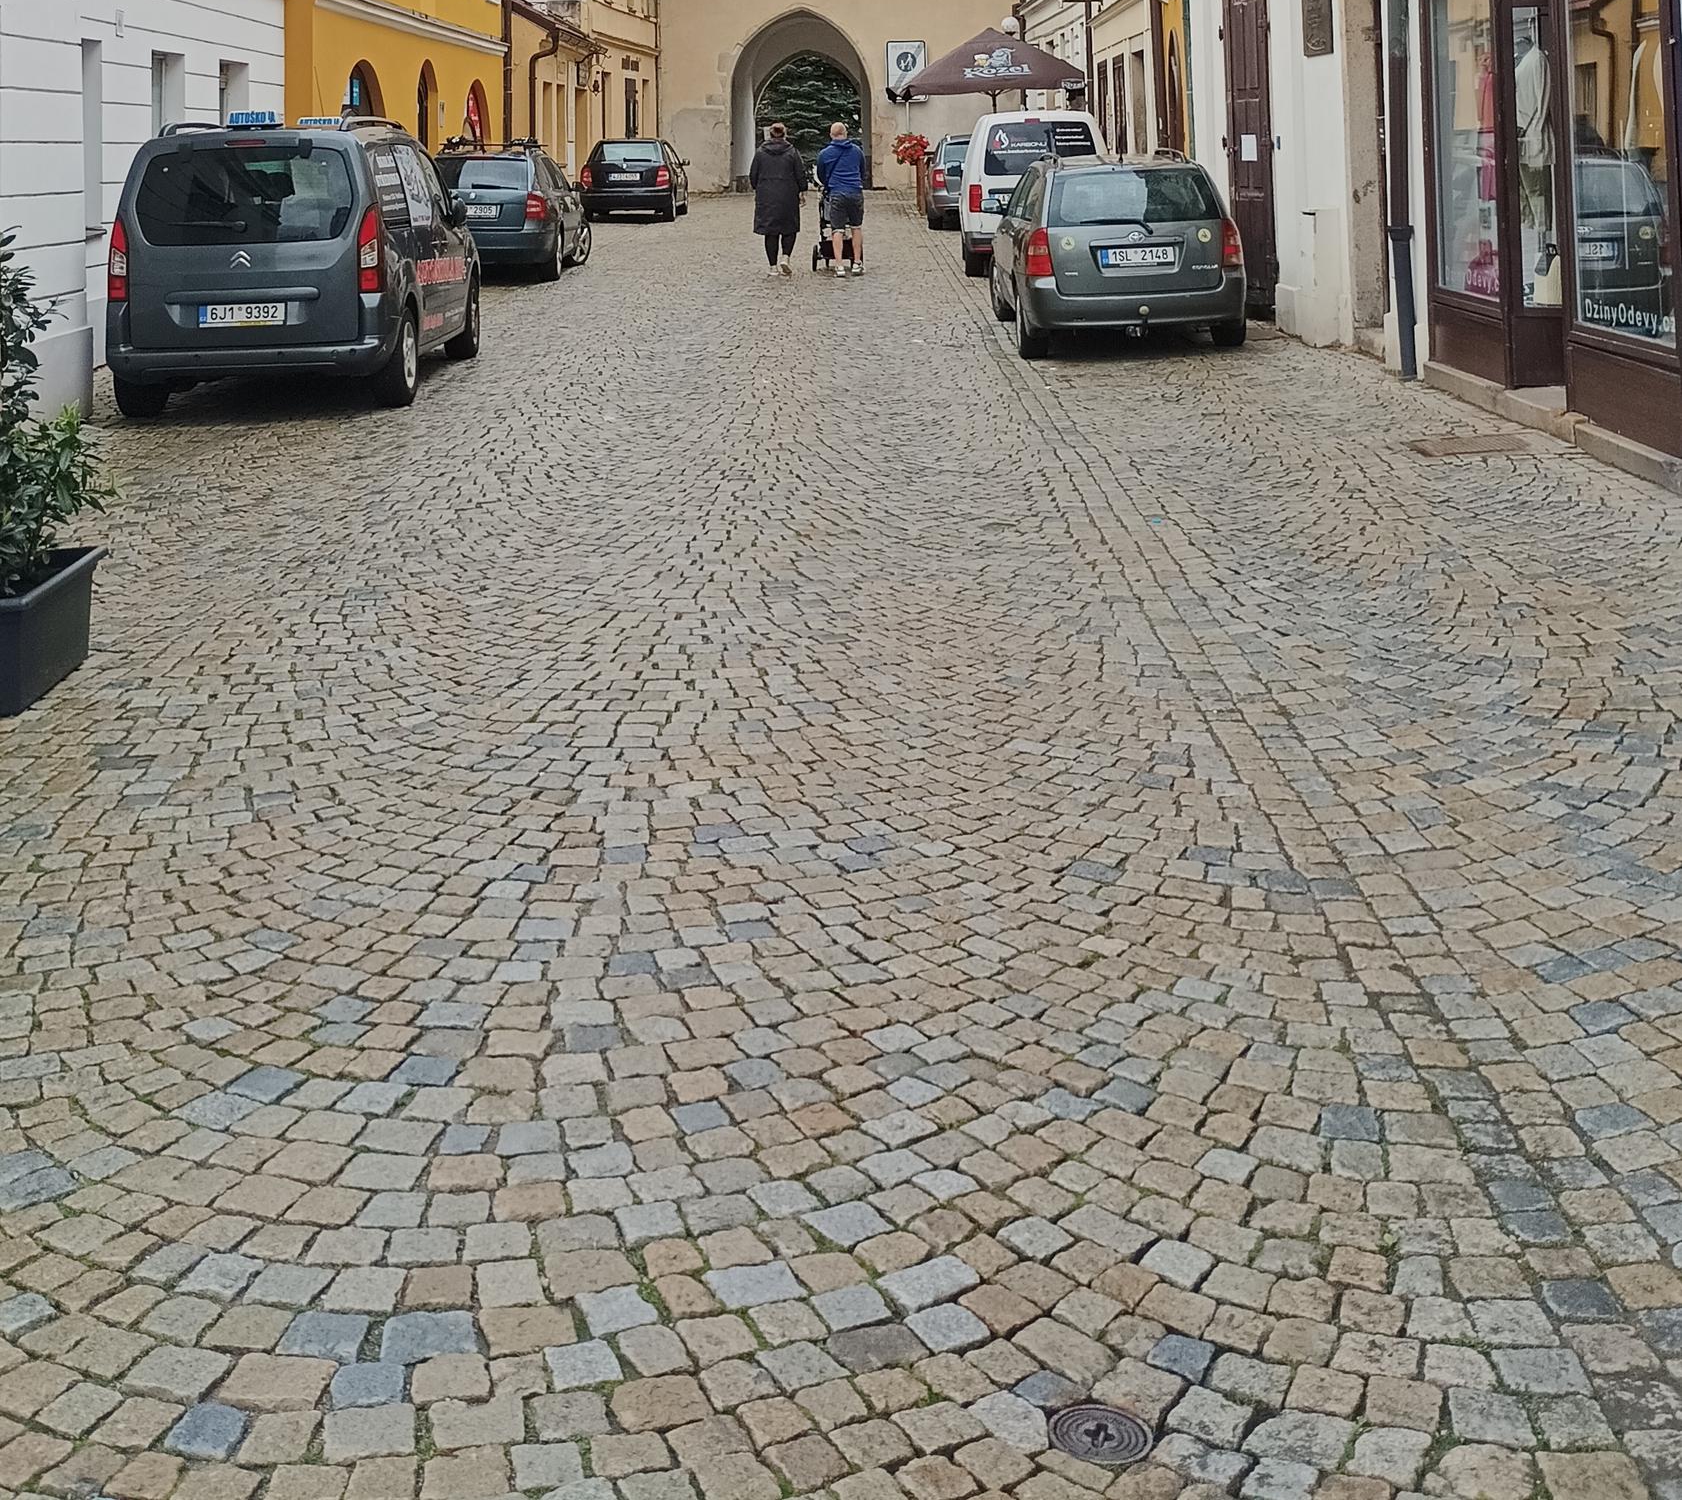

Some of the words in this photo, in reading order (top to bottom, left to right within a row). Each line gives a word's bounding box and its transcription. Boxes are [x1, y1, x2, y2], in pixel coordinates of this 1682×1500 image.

[962, 64, 1033, 79] Kozel
[474, 206, 493, 214] 2905
[1112, 251, 1132, 262] 1SL
[1141, 248, 1169, 261] 2148
[210, 307, 234, 320] 6J1
[245, 305, 278, 319] 9392
